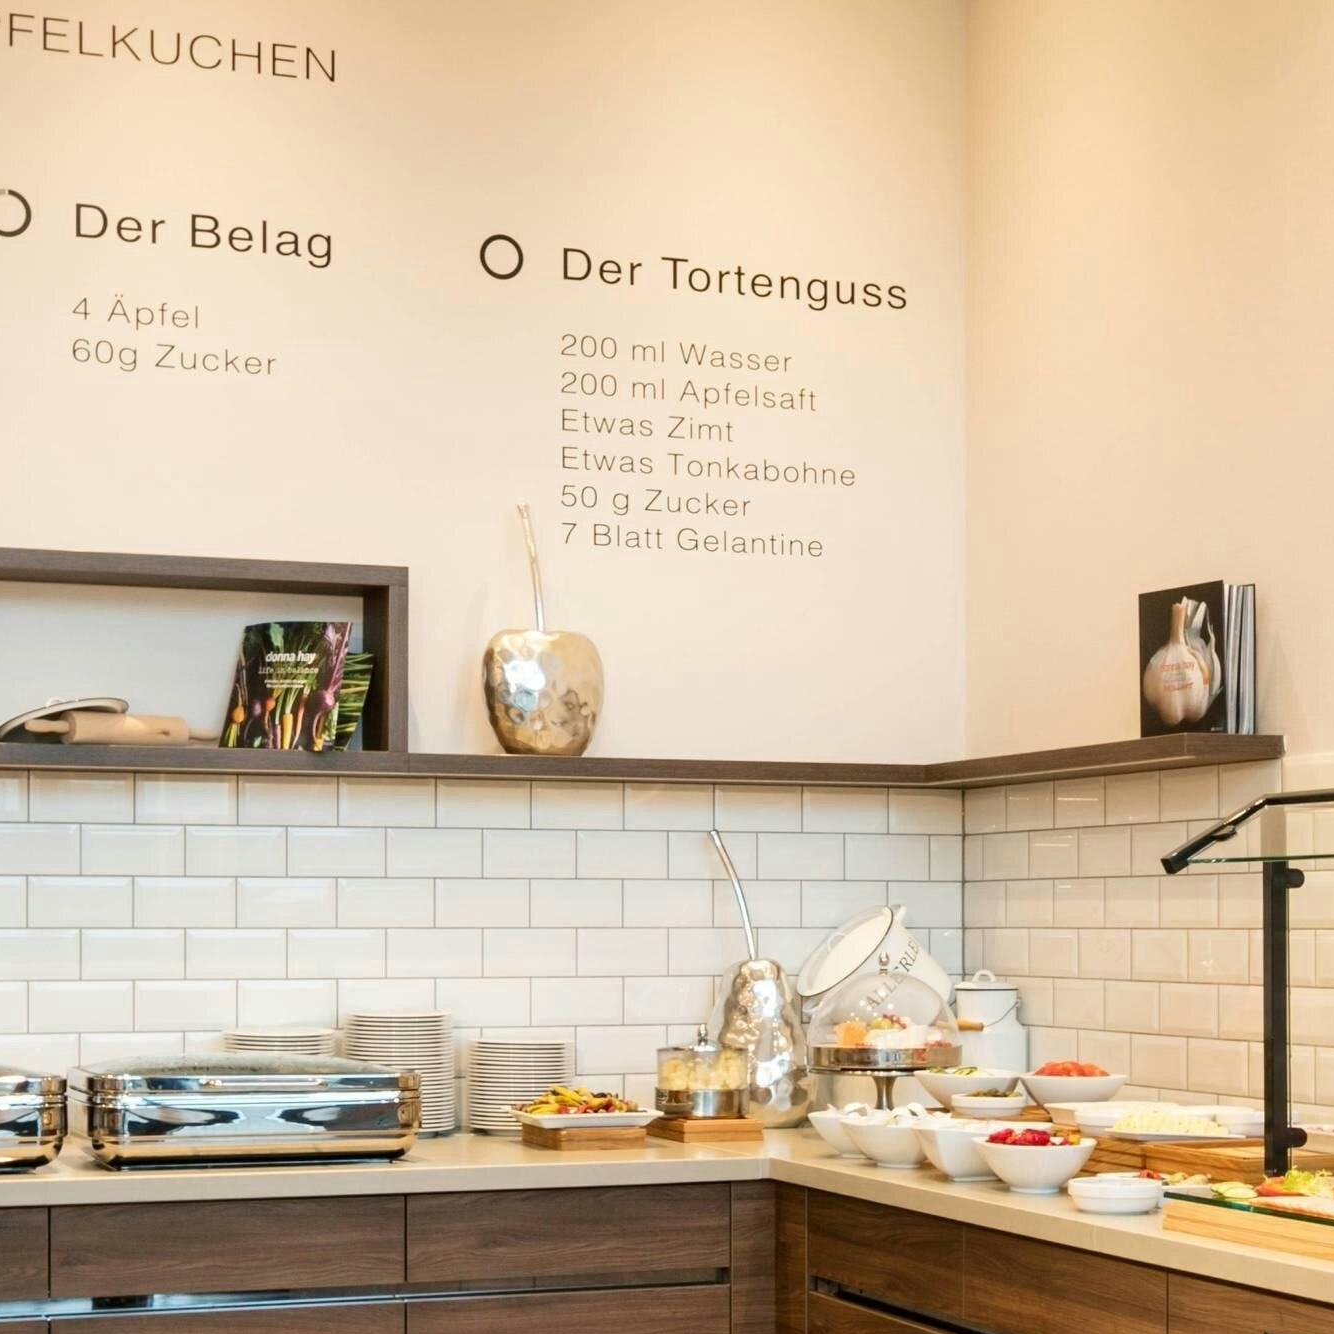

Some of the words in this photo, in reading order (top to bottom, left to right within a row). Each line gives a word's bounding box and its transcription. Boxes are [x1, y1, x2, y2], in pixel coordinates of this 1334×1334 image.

[74, 202, 168, 245] Der
[190, 213, 332, 269] Belag
[562, 247, 643, 287] Der
[660, 256, 908, 312] Tortenguss
[71, 296, 91, 321] 4
[106, 293, 199, 331] Äpfel
[71, 338, 138, 373] 60g
[154, 343, 277, 376] Zucker
[560, 333, 618, 360] 200
[631, 340, 665, 363] ml
[678, 341, 792, 373] Wasser
[560, 371, 618, 398] 200
[631, 378, 665, 401] ml
[679, 379, 816, 412] Apfelsaft
[561, 408, 654, 437] Etwas
[667, 415, 733, 443] Zimt
[561, 445, 654, 475] Etwas
[666, 452, 856, 487] Tonkabohne
[560, 484, 598, 509] 50
[612, 492, 630, 517] g
[644, 488, 751, 517] Zucker
[561, 522, 578, 545] 7
[593, 523, 663, 551] Blatt
[676, 527, 824, 558] Gelantine
[265, 650, 296, 663] donna
[297, 650, 317, 665] hay
